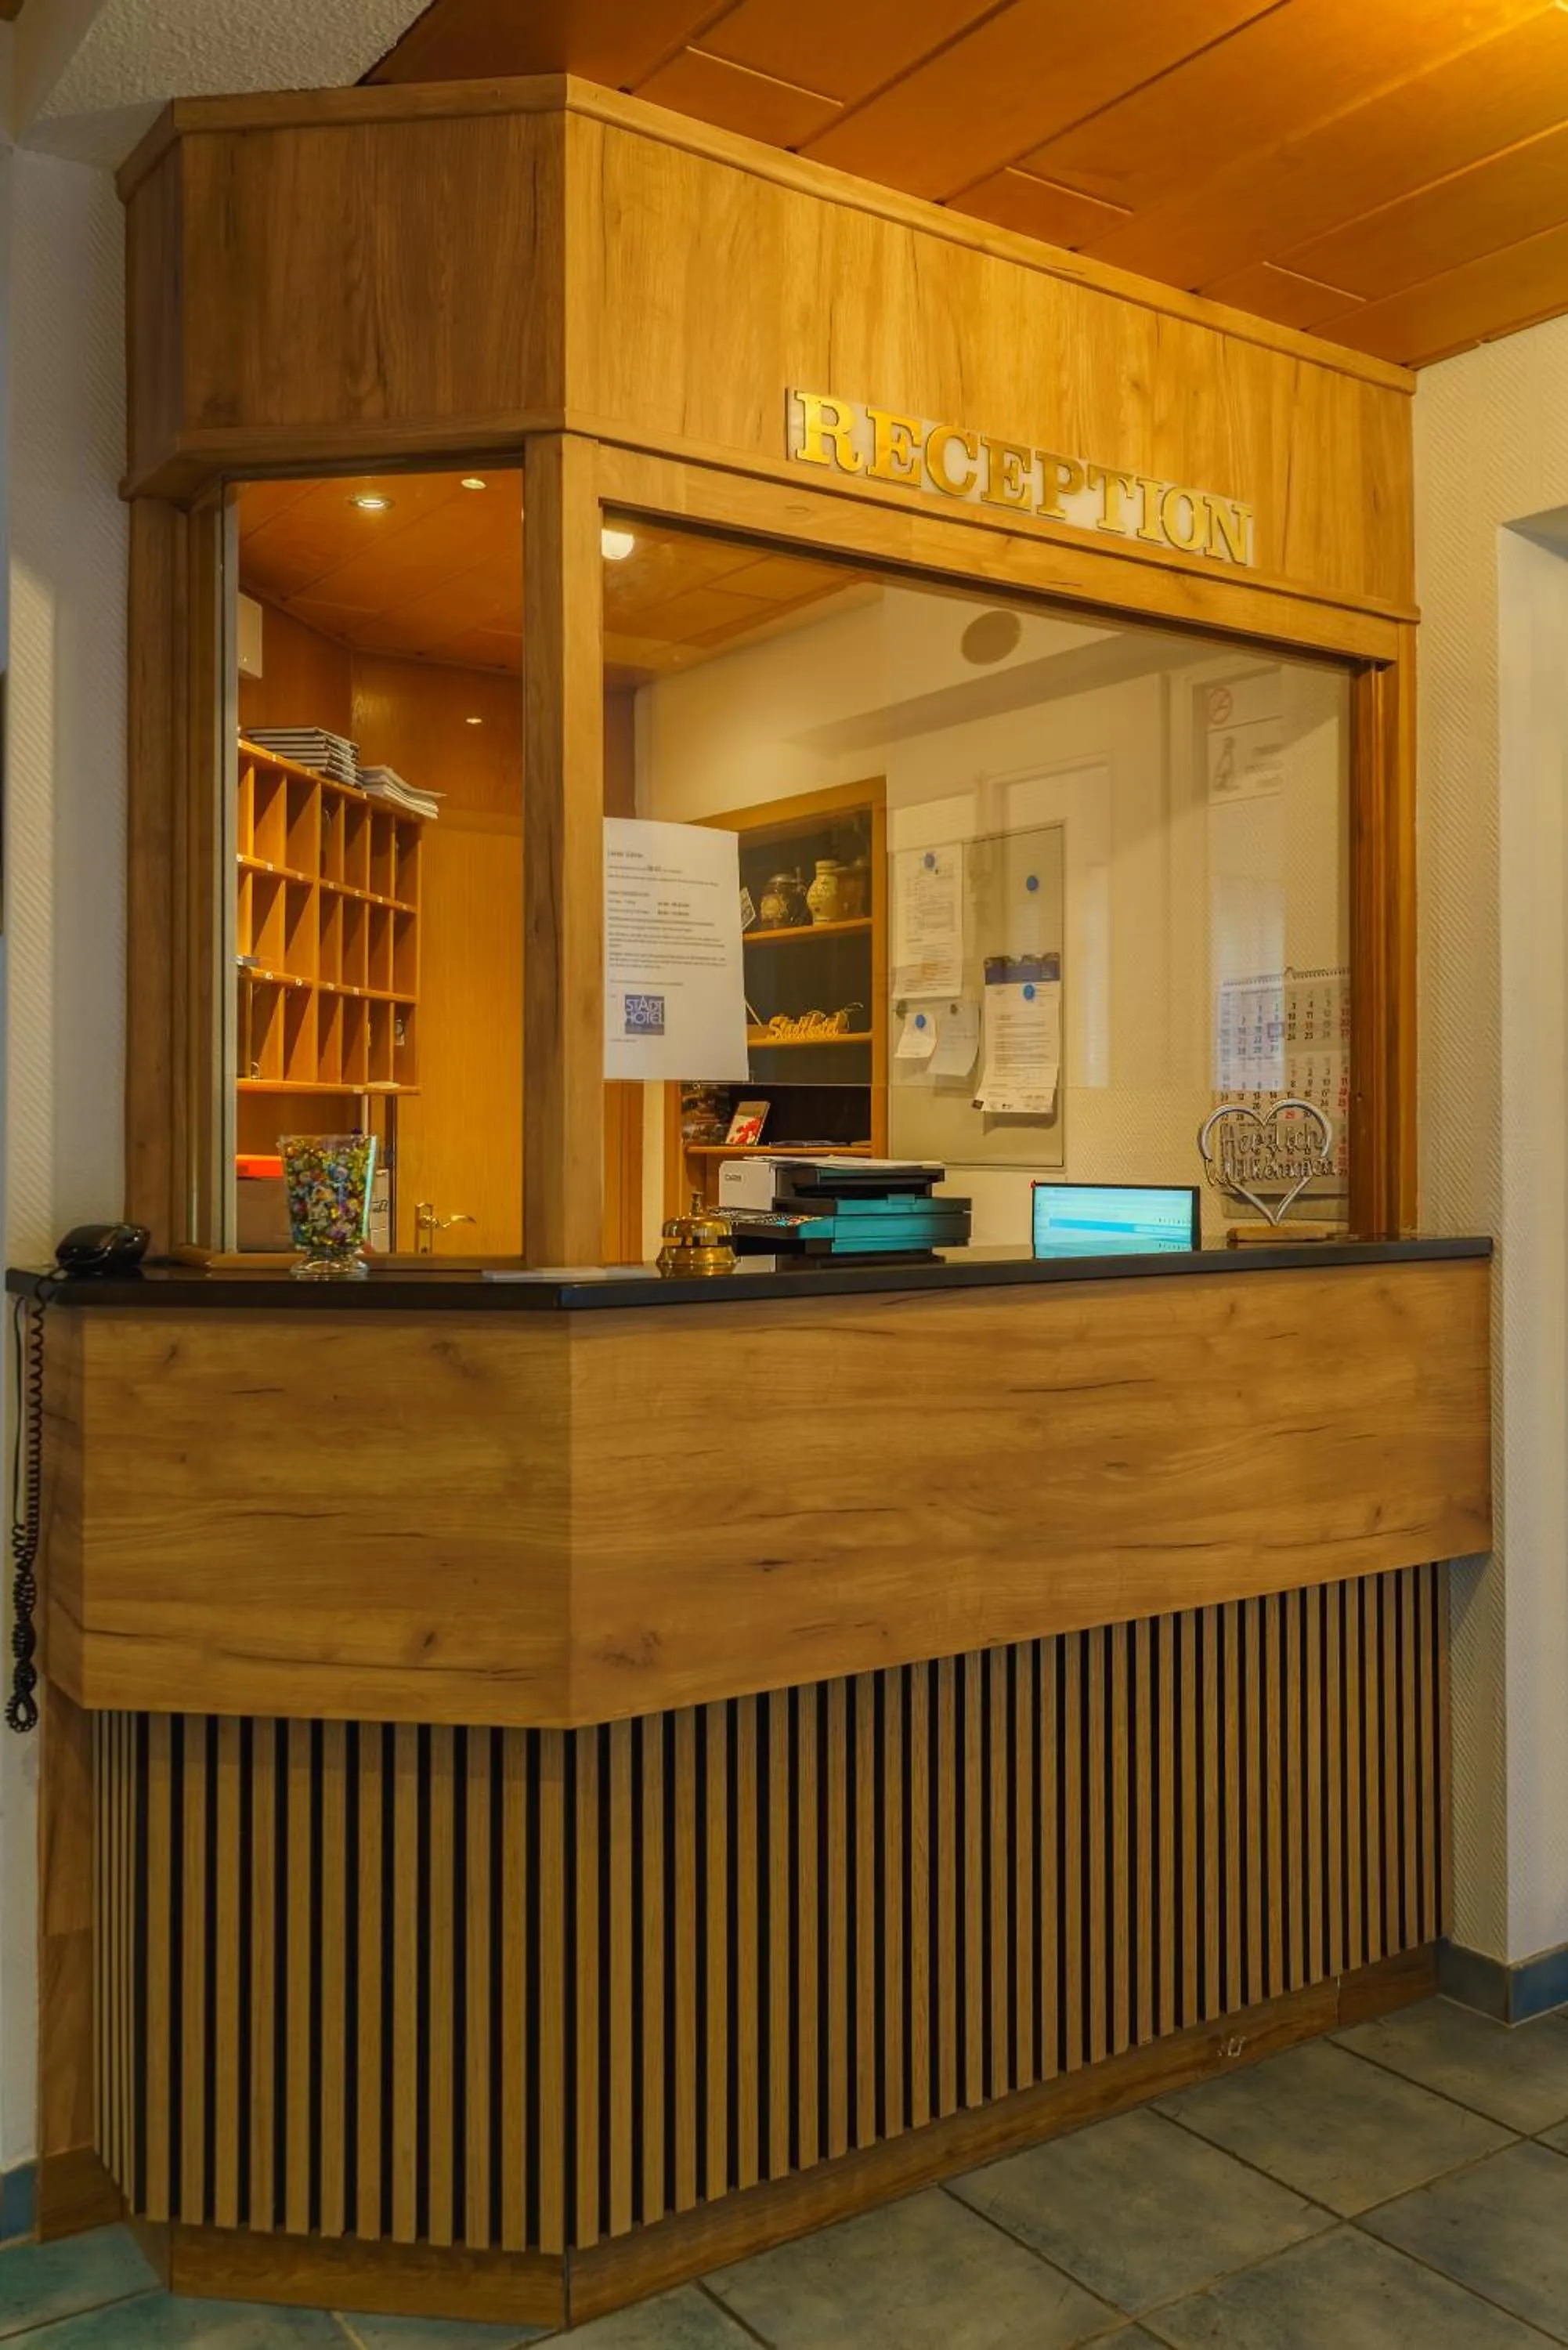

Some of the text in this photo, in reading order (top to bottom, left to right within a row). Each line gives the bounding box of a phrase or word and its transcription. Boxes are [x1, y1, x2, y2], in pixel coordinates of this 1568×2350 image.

[793, 390, 1252, 566] RECEPTION
[627, 996, 663, 1011] STADT
[625, 1011, 664, 1024] HOTEL
